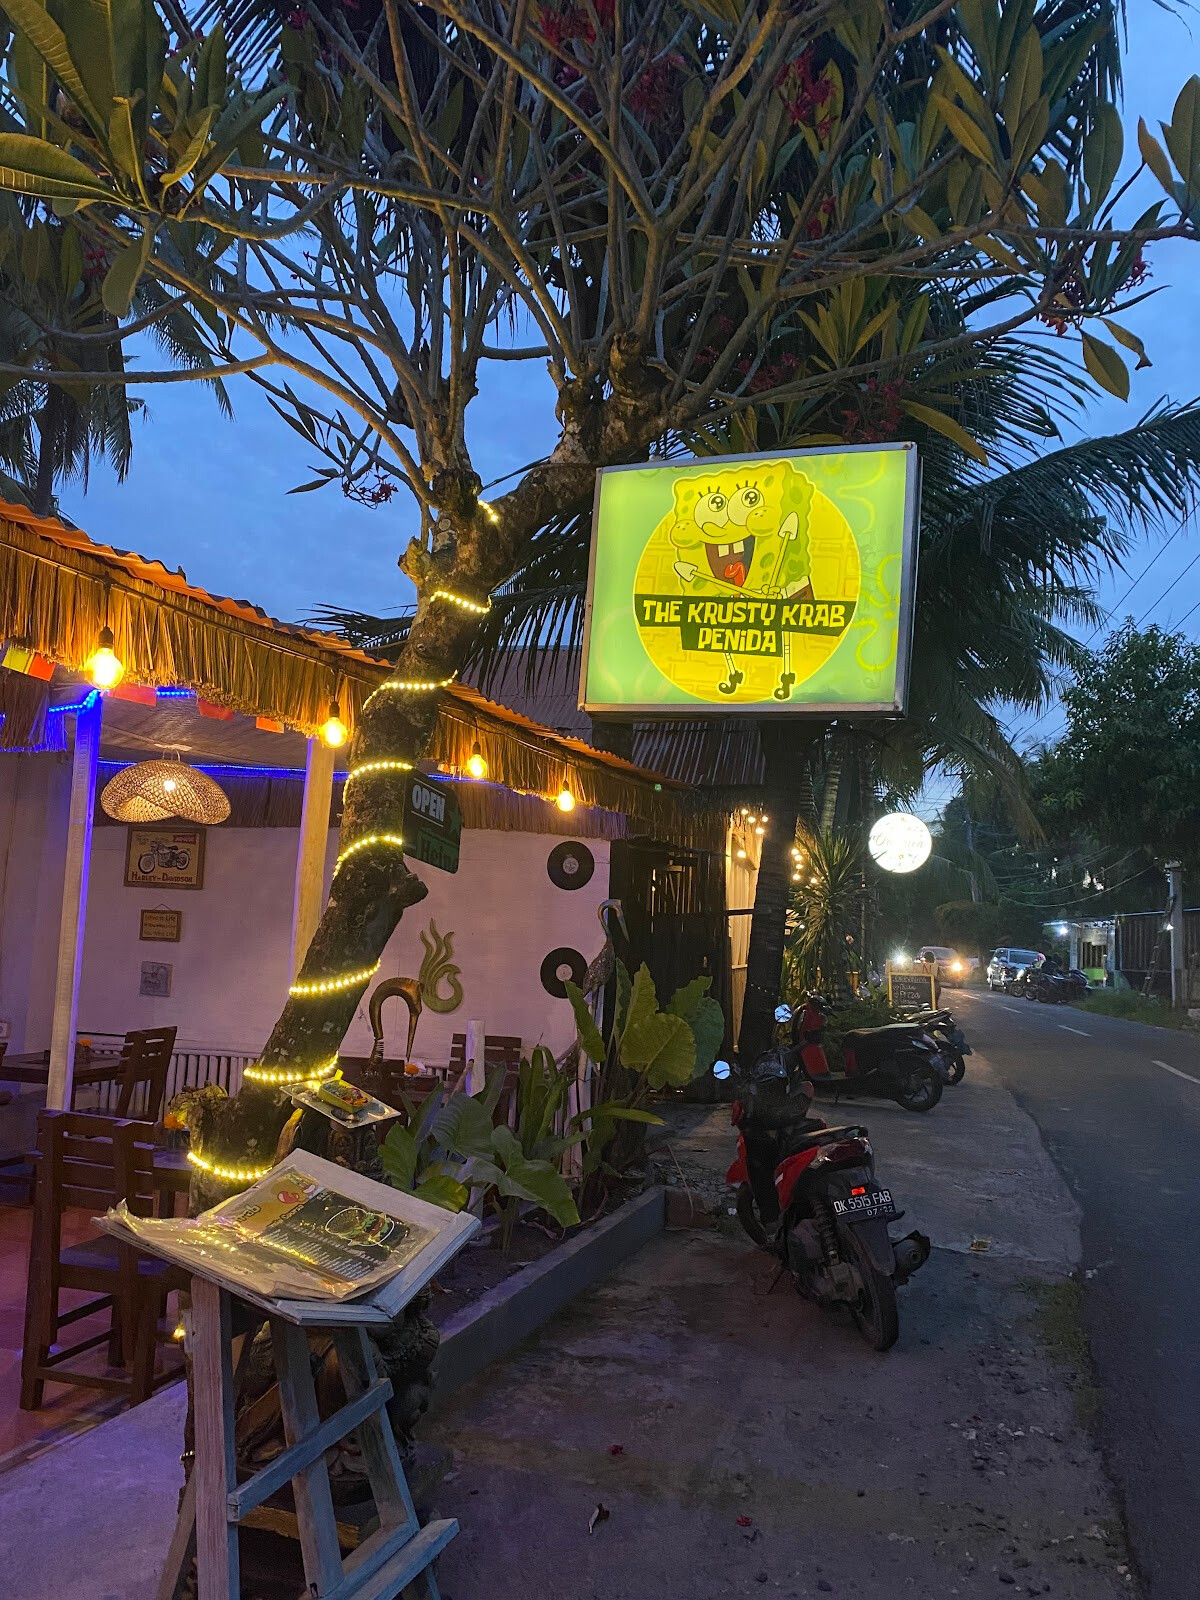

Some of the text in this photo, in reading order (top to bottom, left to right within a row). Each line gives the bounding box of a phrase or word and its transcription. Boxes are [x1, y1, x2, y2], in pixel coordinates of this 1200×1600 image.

[643, 600, 846, 628] THE KRUSTY KRAB
[412, 785, 445, 821] OPEN
[833, 1191, 891, 1213] DK 5515 FAB
